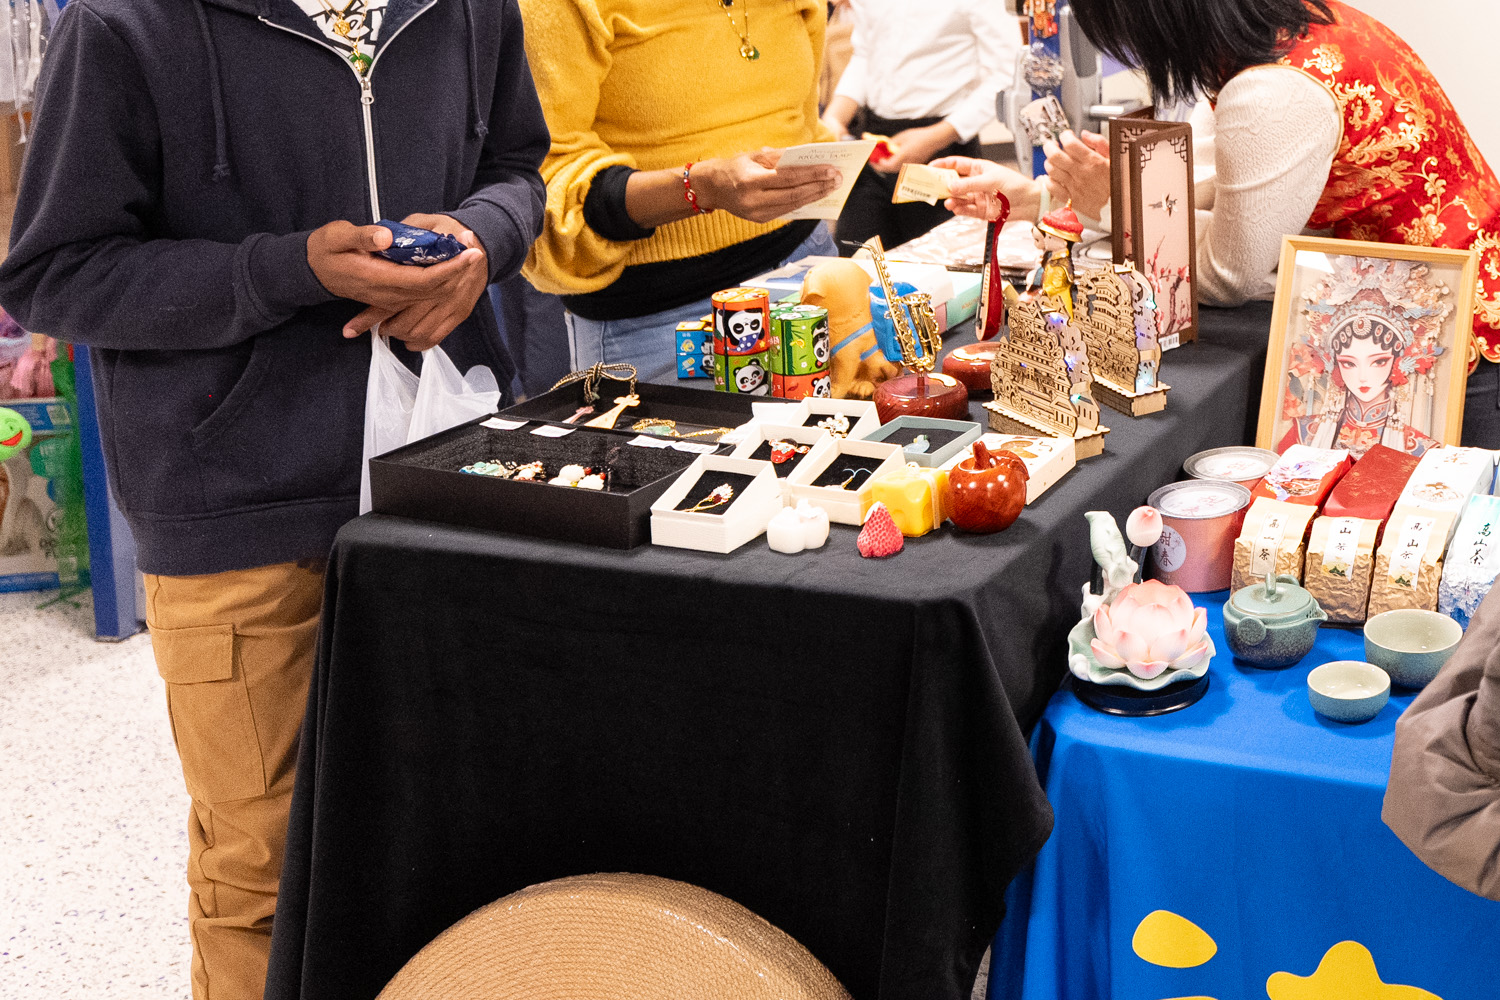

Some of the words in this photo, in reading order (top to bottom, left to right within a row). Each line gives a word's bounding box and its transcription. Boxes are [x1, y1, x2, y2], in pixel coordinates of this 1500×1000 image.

[1334, 520, 1354, 551] 山茶
[1470, 522, 1492, 565] 高山茶
